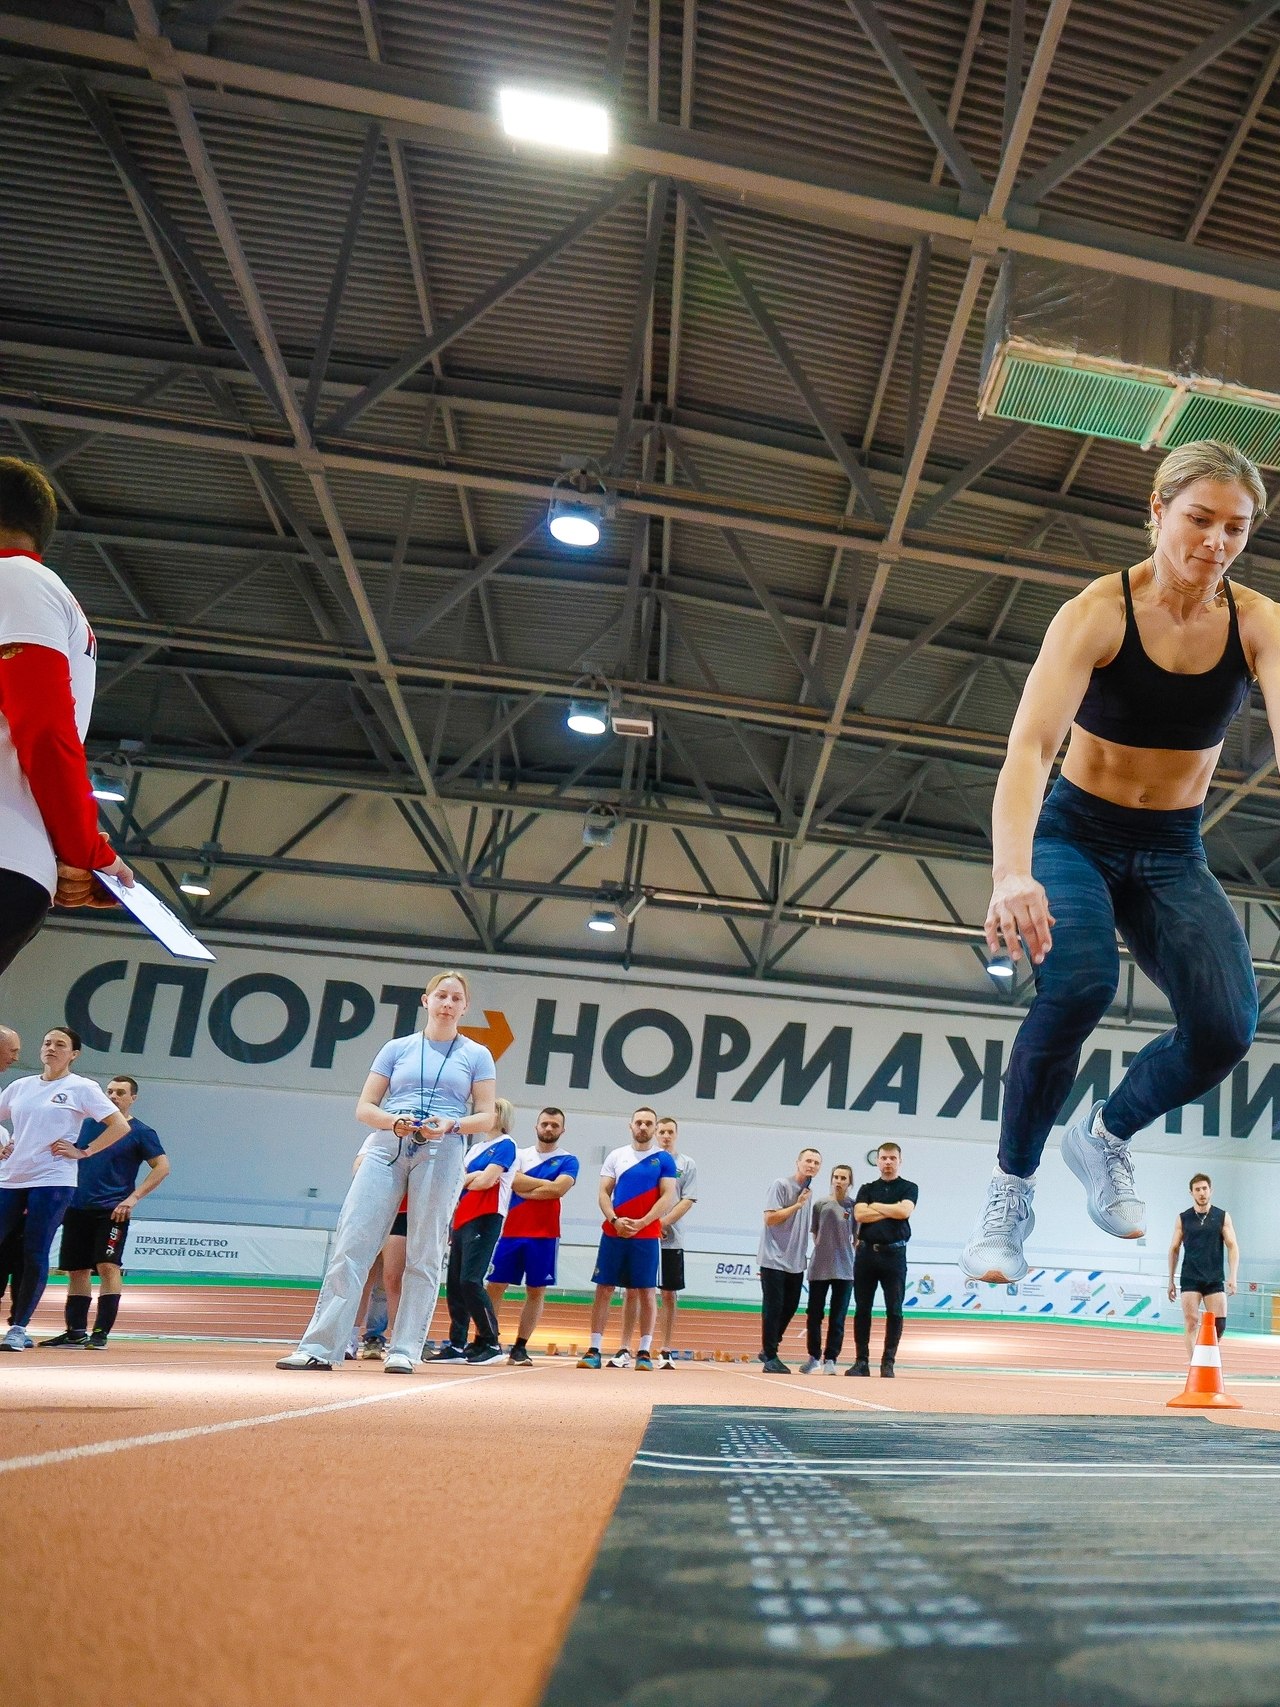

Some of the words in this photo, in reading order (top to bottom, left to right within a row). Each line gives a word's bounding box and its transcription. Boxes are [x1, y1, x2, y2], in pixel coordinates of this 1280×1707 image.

[525, 998, 923, 1116] НОРМА
[136, 1235, 229, 1247] ПРАВИТЕЛЬСТВО
[134, 1247, 186, 1257] КУРСКОЙ
[188, 1249, 239, 1259] ОБЛАСТИ
[716, 1262, 751, 1275] ВФЛА
